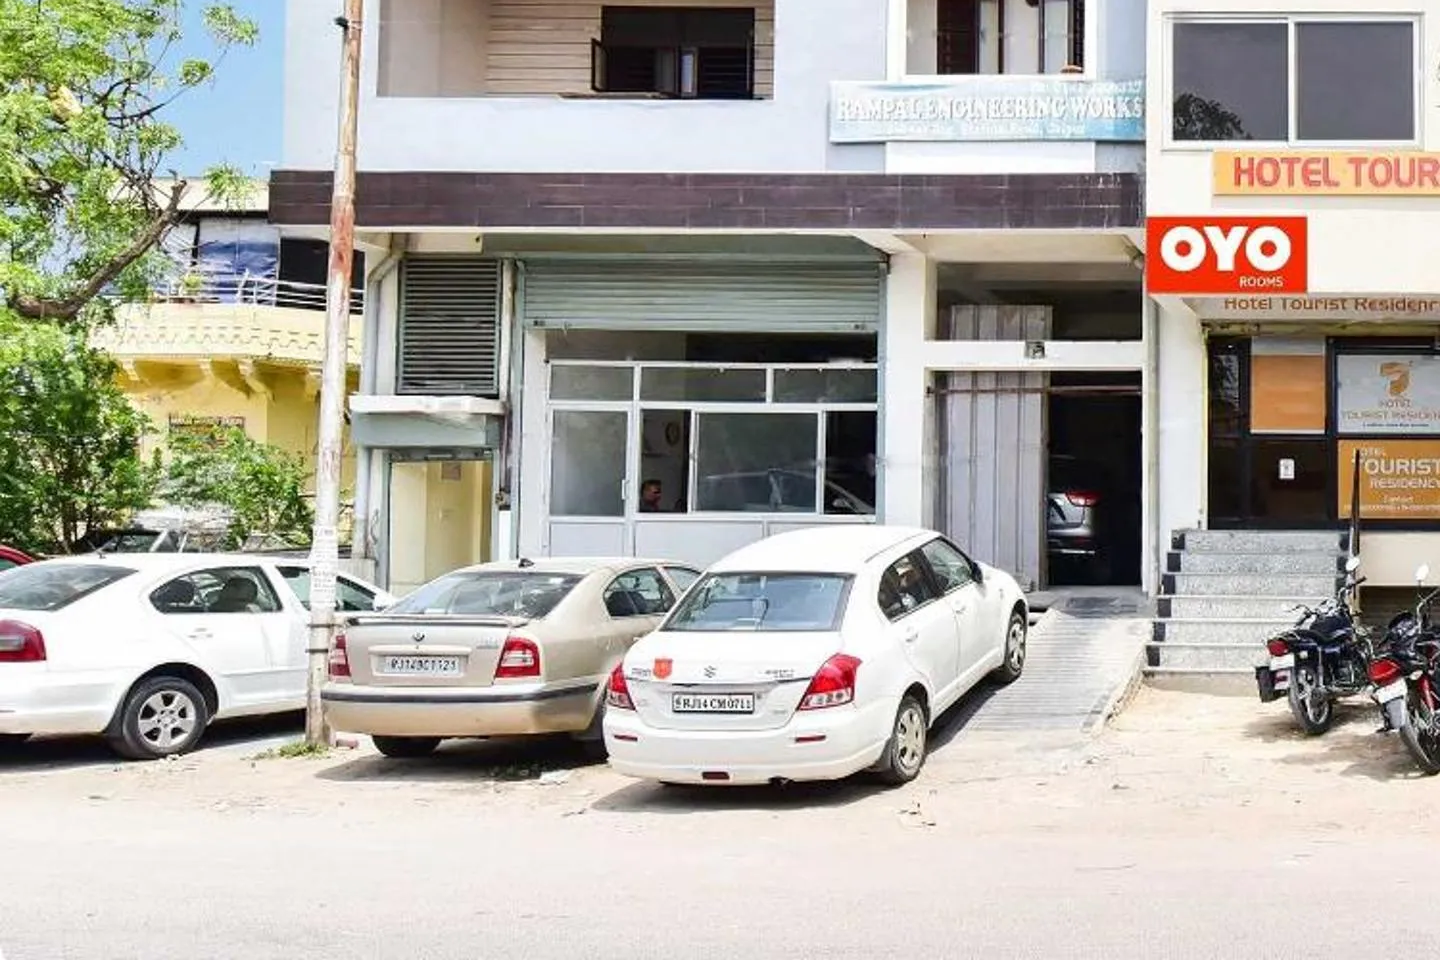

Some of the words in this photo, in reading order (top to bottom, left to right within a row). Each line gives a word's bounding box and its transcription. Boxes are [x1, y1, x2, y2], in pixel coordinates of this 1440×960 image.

[1070, 95, 1143, 120] WORKS
[1233, 157, 1341, 188] HOTEL
[1160, 225, 1292, 272] OYO
[1239, 276, 1284, 287] ROOMS
[1224, 297, 1272, 310] Hotel
[1280, 297, 1347, 311] Tourist
